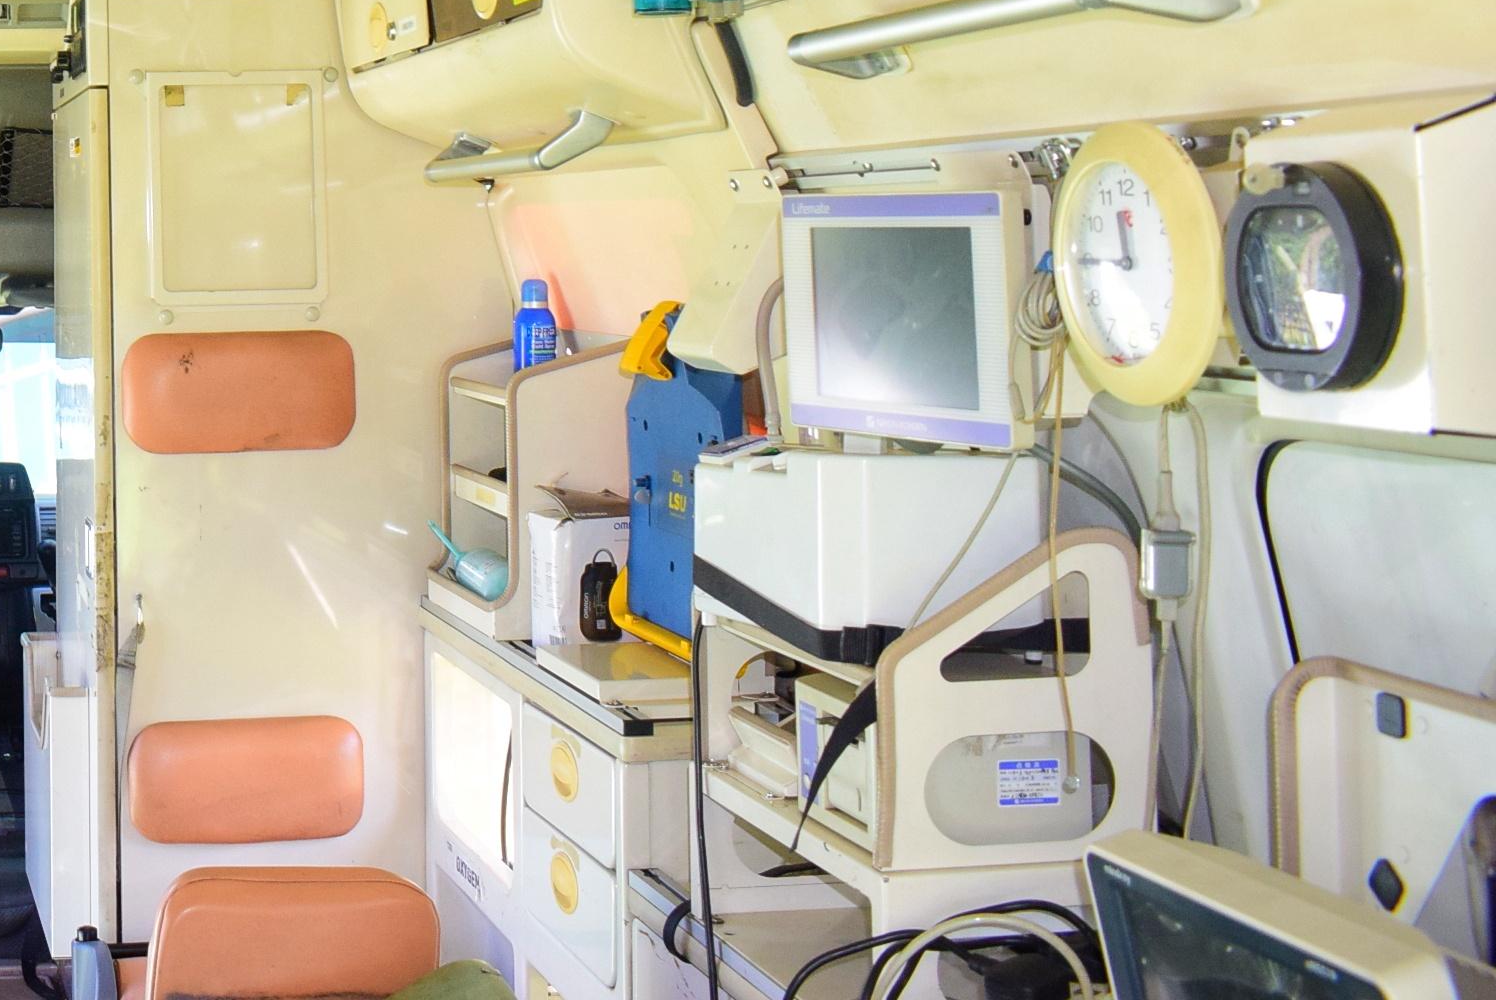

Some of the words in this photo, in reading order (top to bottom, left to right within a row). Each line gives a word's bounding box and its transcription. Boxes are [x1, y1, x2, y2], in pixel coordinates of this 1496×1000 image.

[1117, 178, 1135, 197] 12
[1098, 189, 1113, 207] 11
[1144, 190, 1151, 208] 1
[1087, 214, 1104, 233] 10
[1089, 288, 1102, 307] 8
[1105, 317, 1116, 337] 7
[1149, 321, 1161, 341] 5
[668, 491, 687, 513] LSU
